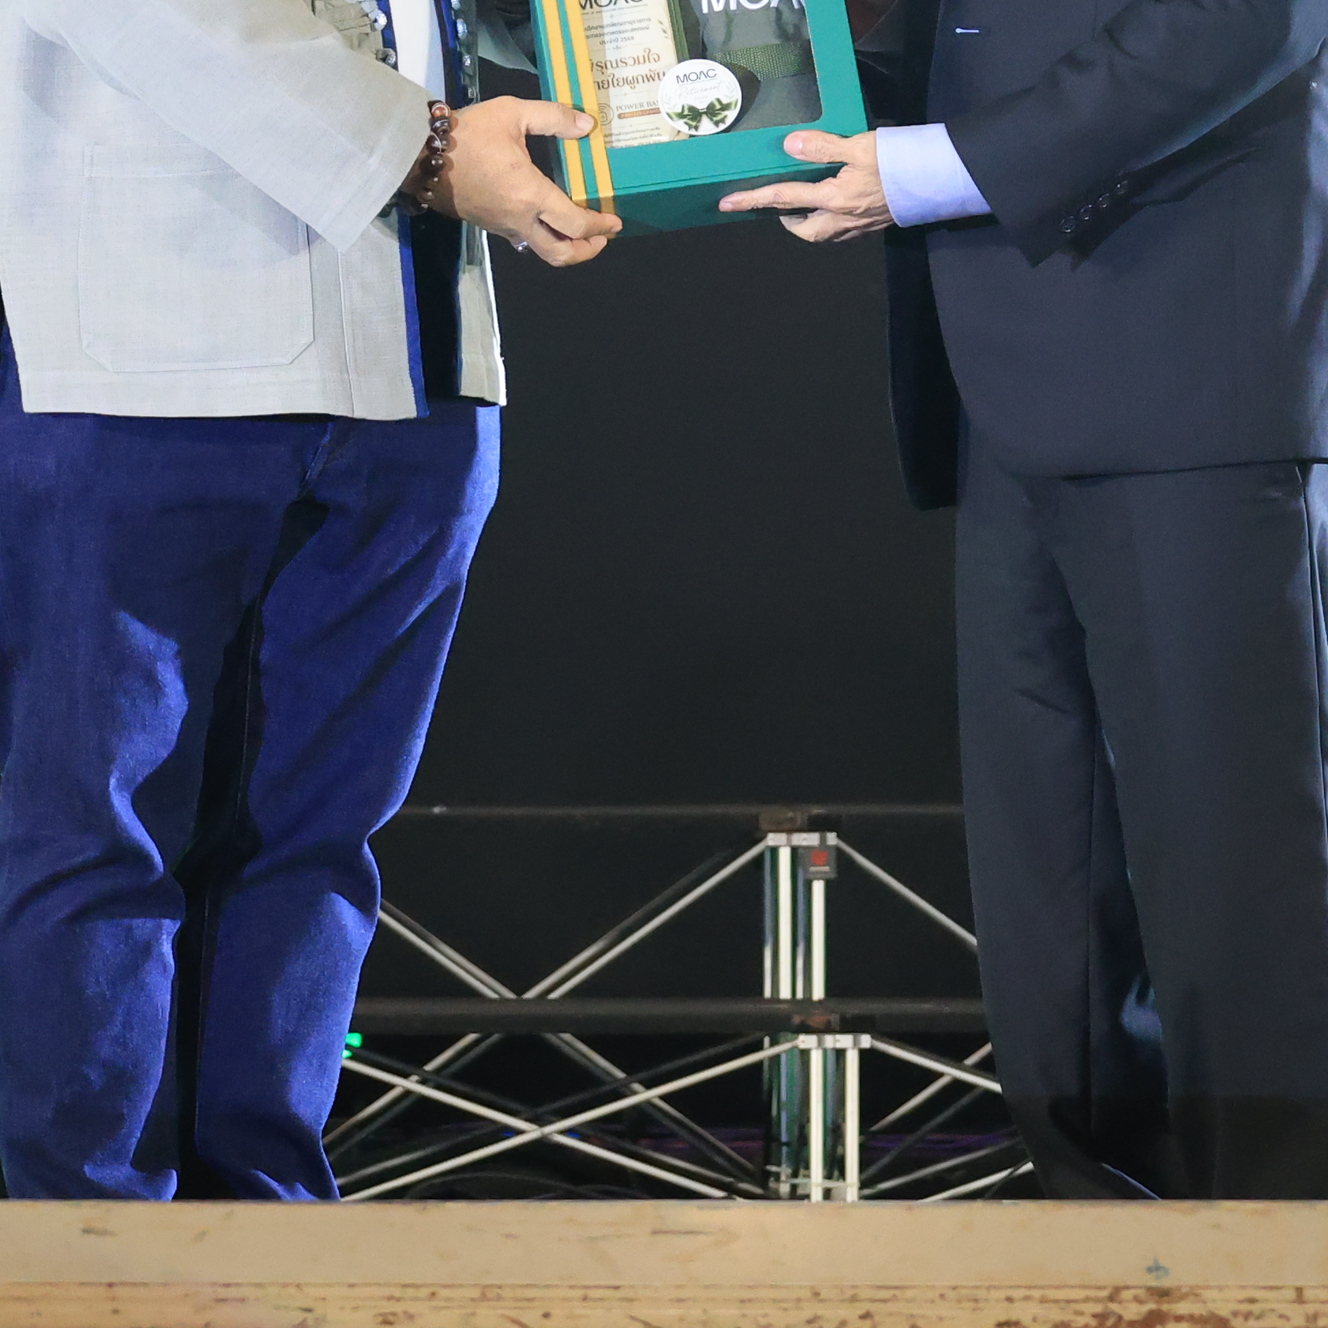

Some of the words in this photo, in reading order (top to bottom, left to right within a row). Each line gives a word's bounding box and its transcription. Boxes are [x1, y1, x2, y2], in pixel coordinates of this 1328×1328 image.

[593, 68, 666, 90] ายใยผูกพัน
[676, 68, 717, 84] MOAC
[616, 102, 644, 112] POWER
